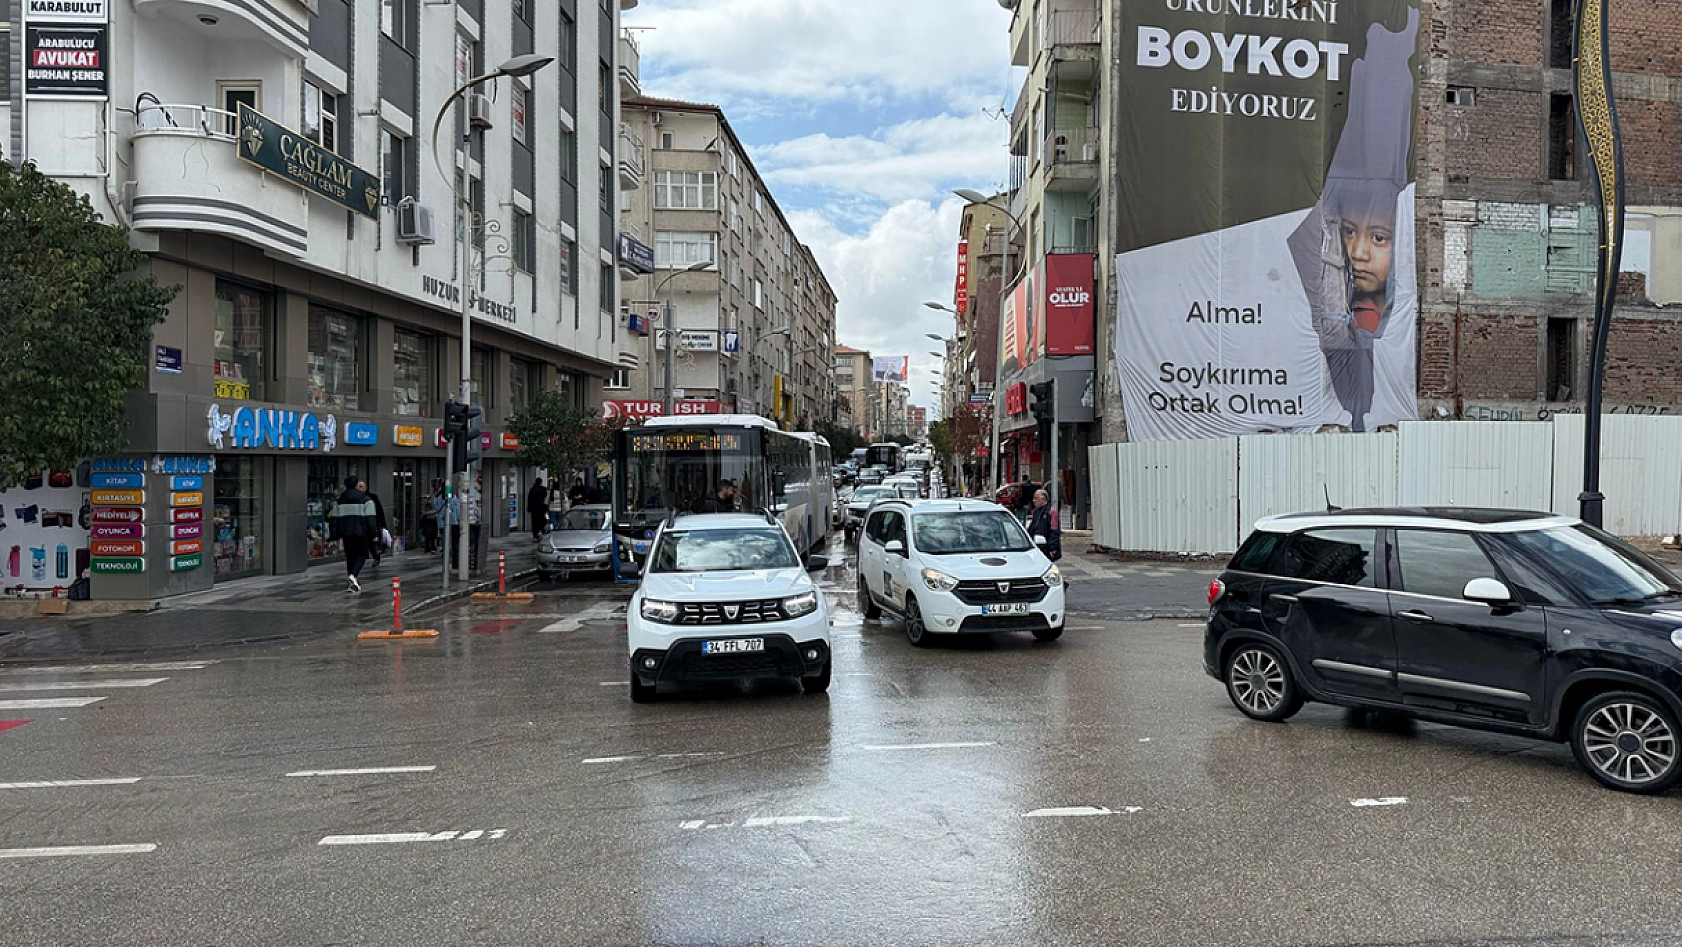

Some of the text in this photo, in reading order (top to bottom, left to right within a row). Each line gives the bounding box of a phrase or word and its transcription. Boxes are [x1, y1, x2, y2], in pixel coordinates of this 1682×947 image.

[31, 1, 102, 13] KARABULUT
[38, 38, 95, 48] ARABULUCU
[38, 51, 96, 66] AVUKAT
[1137, 25, 1349, 81] BOYKOT
[28, 69, 104, 82] BURHAN ŞENER
[1170, 86, 1316, 121] EDİYORUZ
[280, 134, 353, 189] ÇAĞLAM
[287, 162, 347, 199] BEAUTY CENTER
[423, 275, 460, 303] HUZUR
[1049, 293, 1090, 303] OLUR
[1186, 300, 1262, 324] Alma!
[1159, 362, 1288, 389] Soykırıma
[623, 402, 706, 414] TURISH
[1149, 391, 1303, 415] Ortak Olma!
[232, 406, 319, 449] ANKA
[93, 457, 145, 471] ANKA
[106, 476, 128, 484] KİTAP
[96, 562, 137, 570] TEKNOLOJİ
[708, 640, 762, 652] 34 FFL 707
